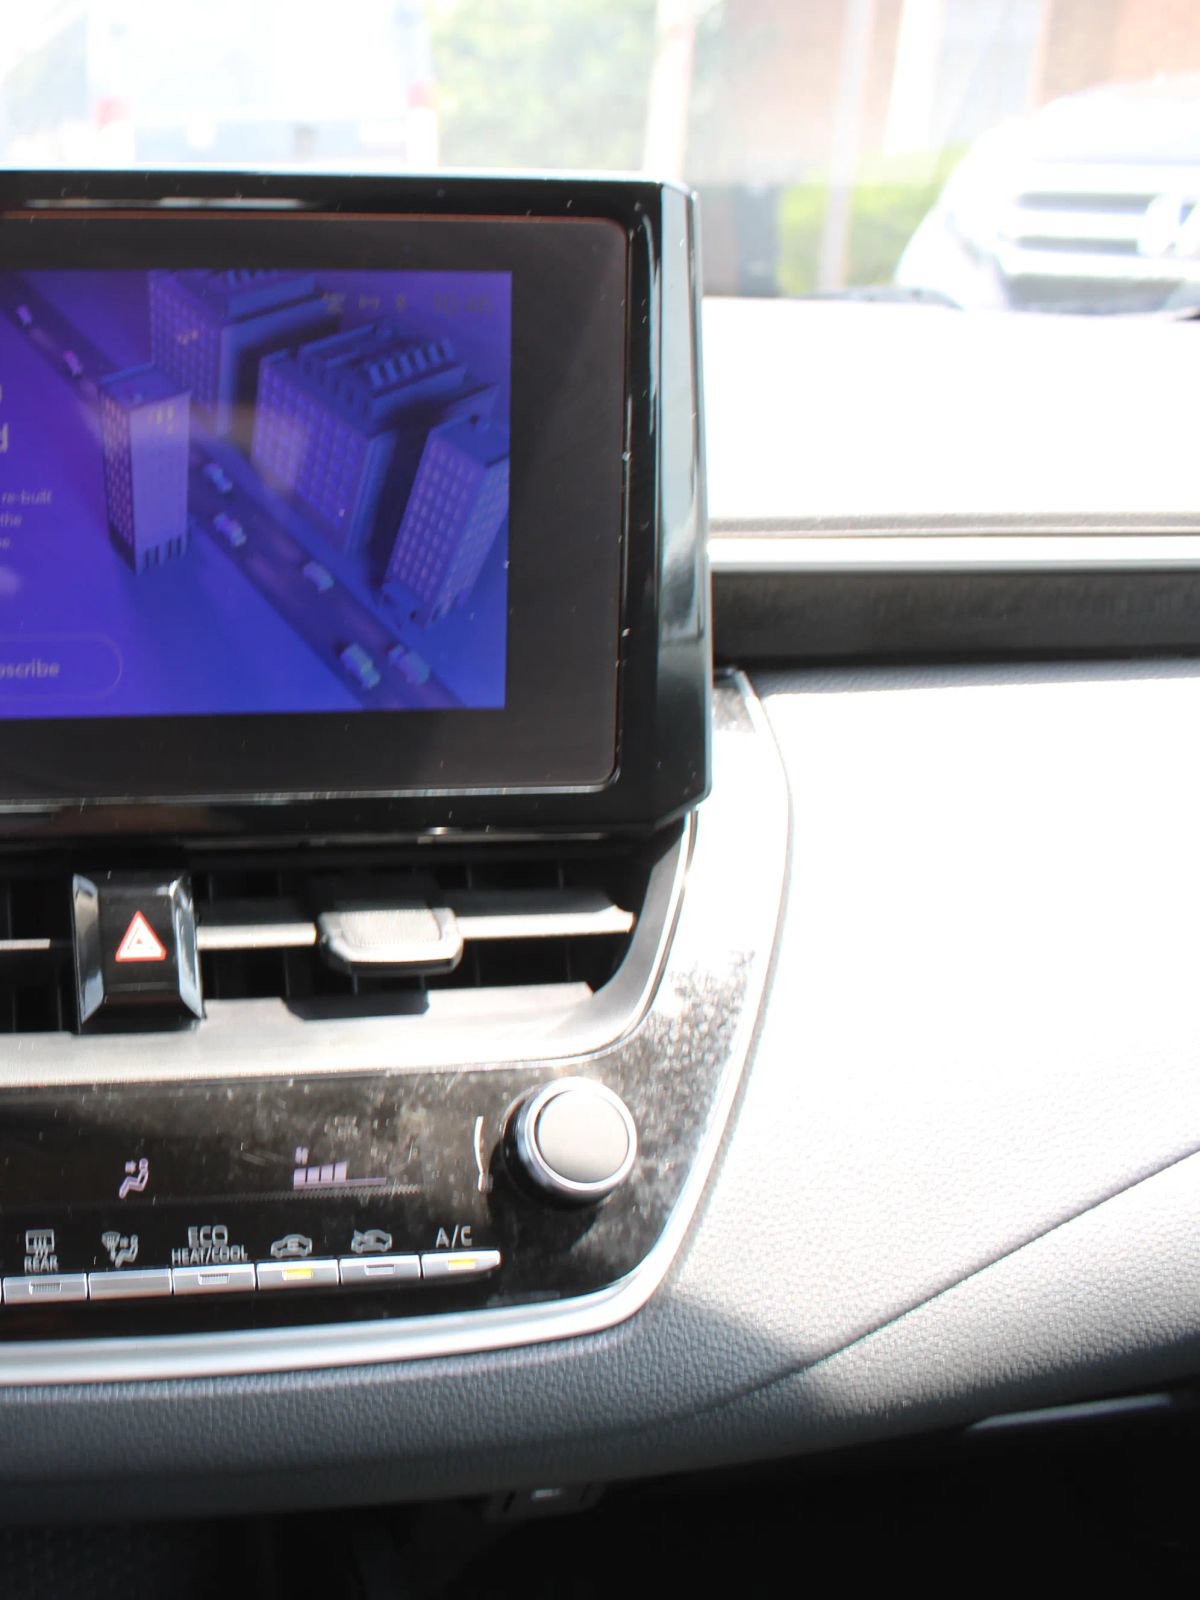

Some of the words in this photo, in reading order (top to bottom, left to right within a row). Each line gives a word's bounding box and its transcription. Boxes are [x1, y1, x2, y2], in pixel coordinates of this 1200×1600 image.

[0, 512, 22, 529] the
[187, 1224, 230, 1248] ECO
[435, 1224, 474, 1248] A/C
[23, 1255, 59, 1274] REAR
[171, 1244, 249, 1266] HEAT/COOL
